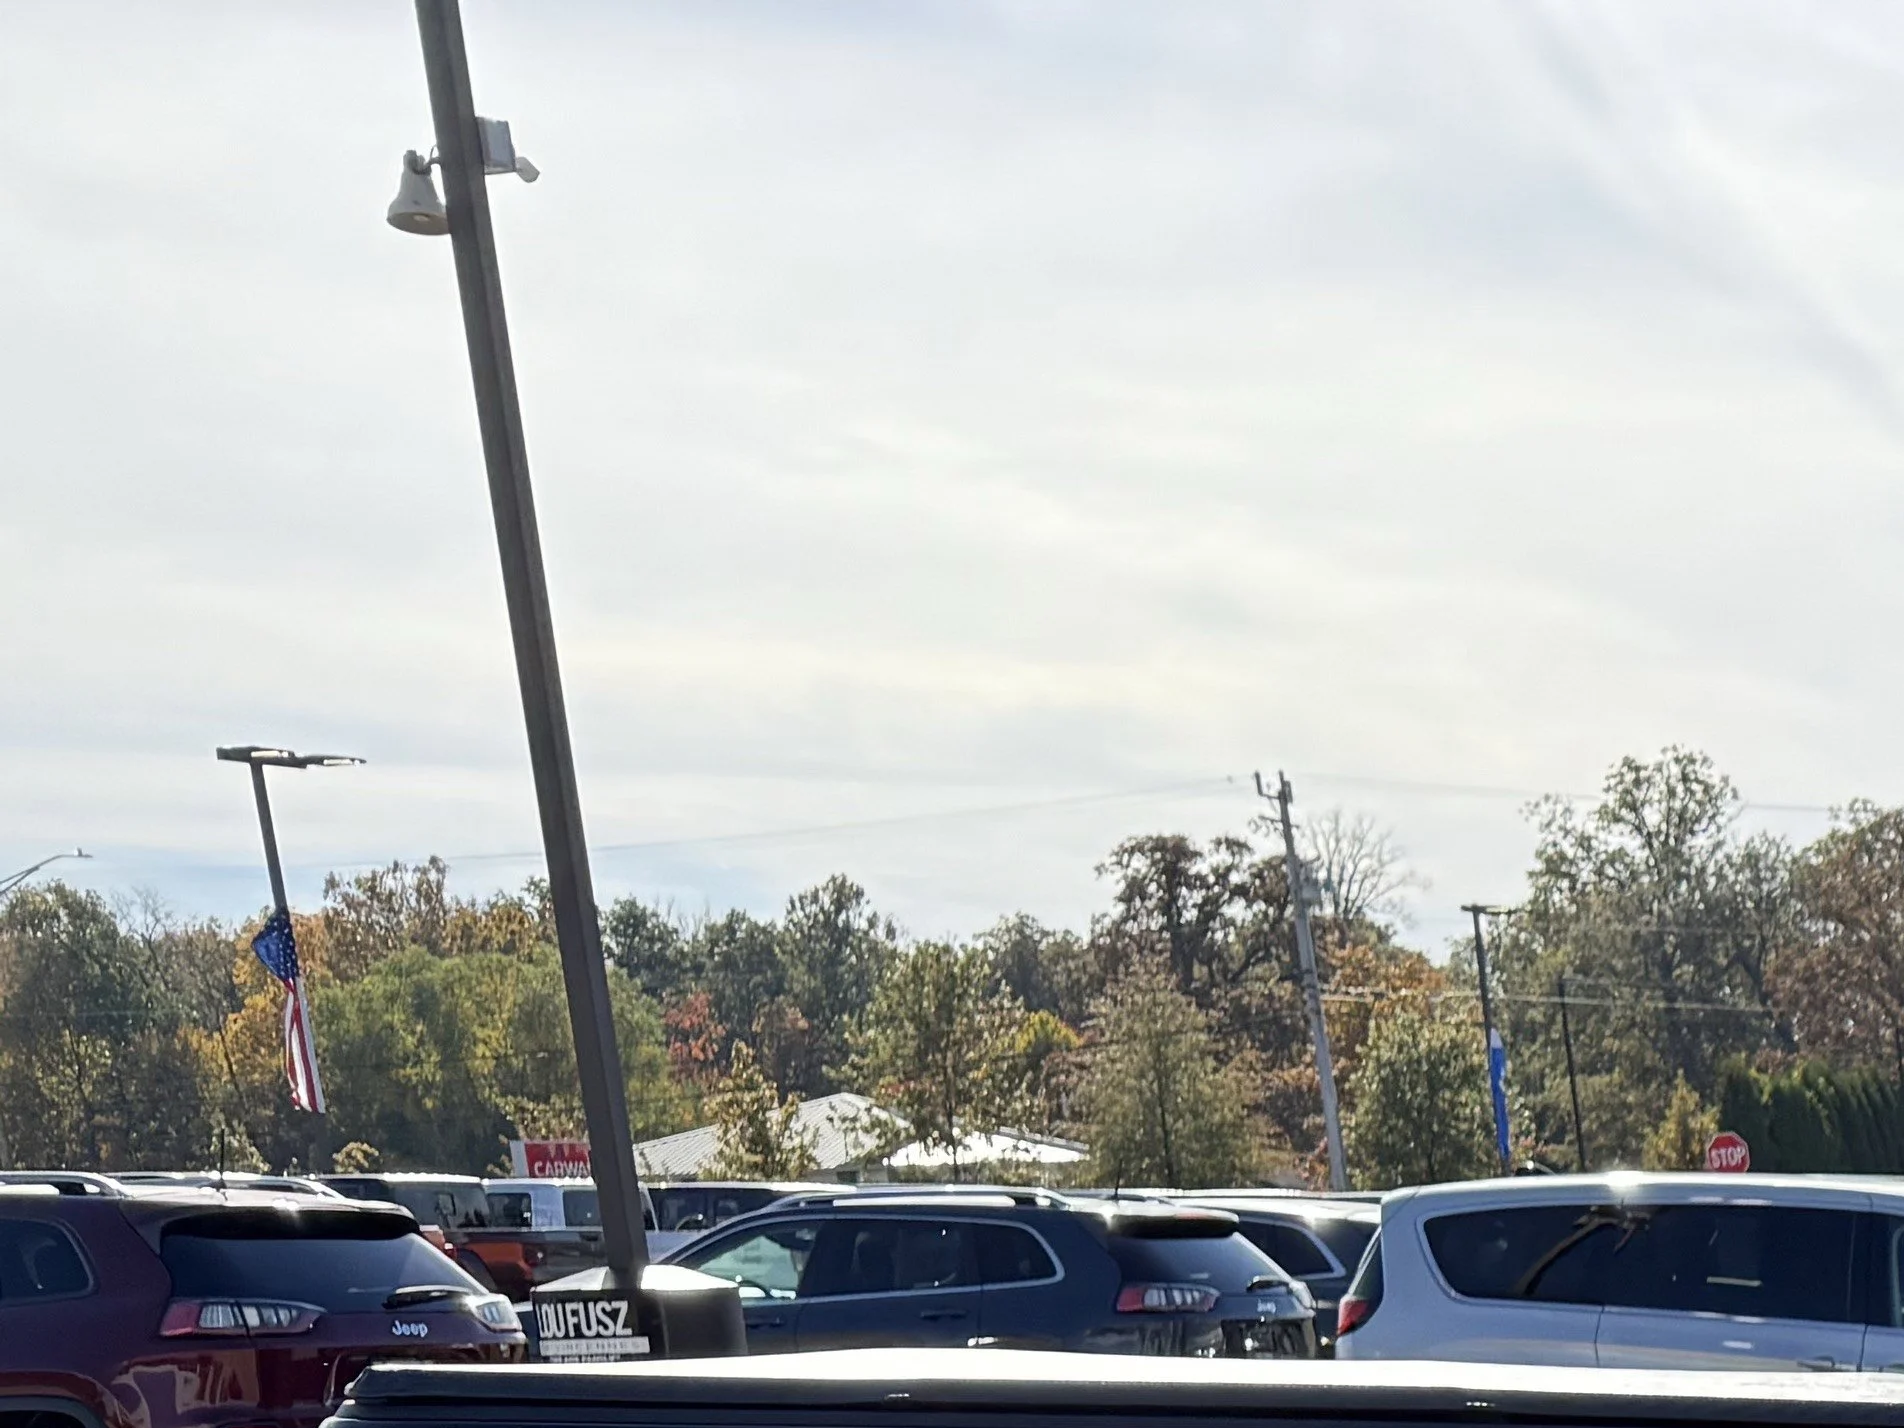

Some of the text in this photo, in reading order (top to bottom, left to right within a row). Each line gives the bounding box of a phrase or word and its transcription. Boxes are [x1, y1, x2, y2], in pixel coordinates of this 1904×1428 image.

[1710, 1145, 1747, 1169] STOP
[392, 1319, 428, 1338] Jeep
[536, 1300, 633, 1338] LOU FUSZ
